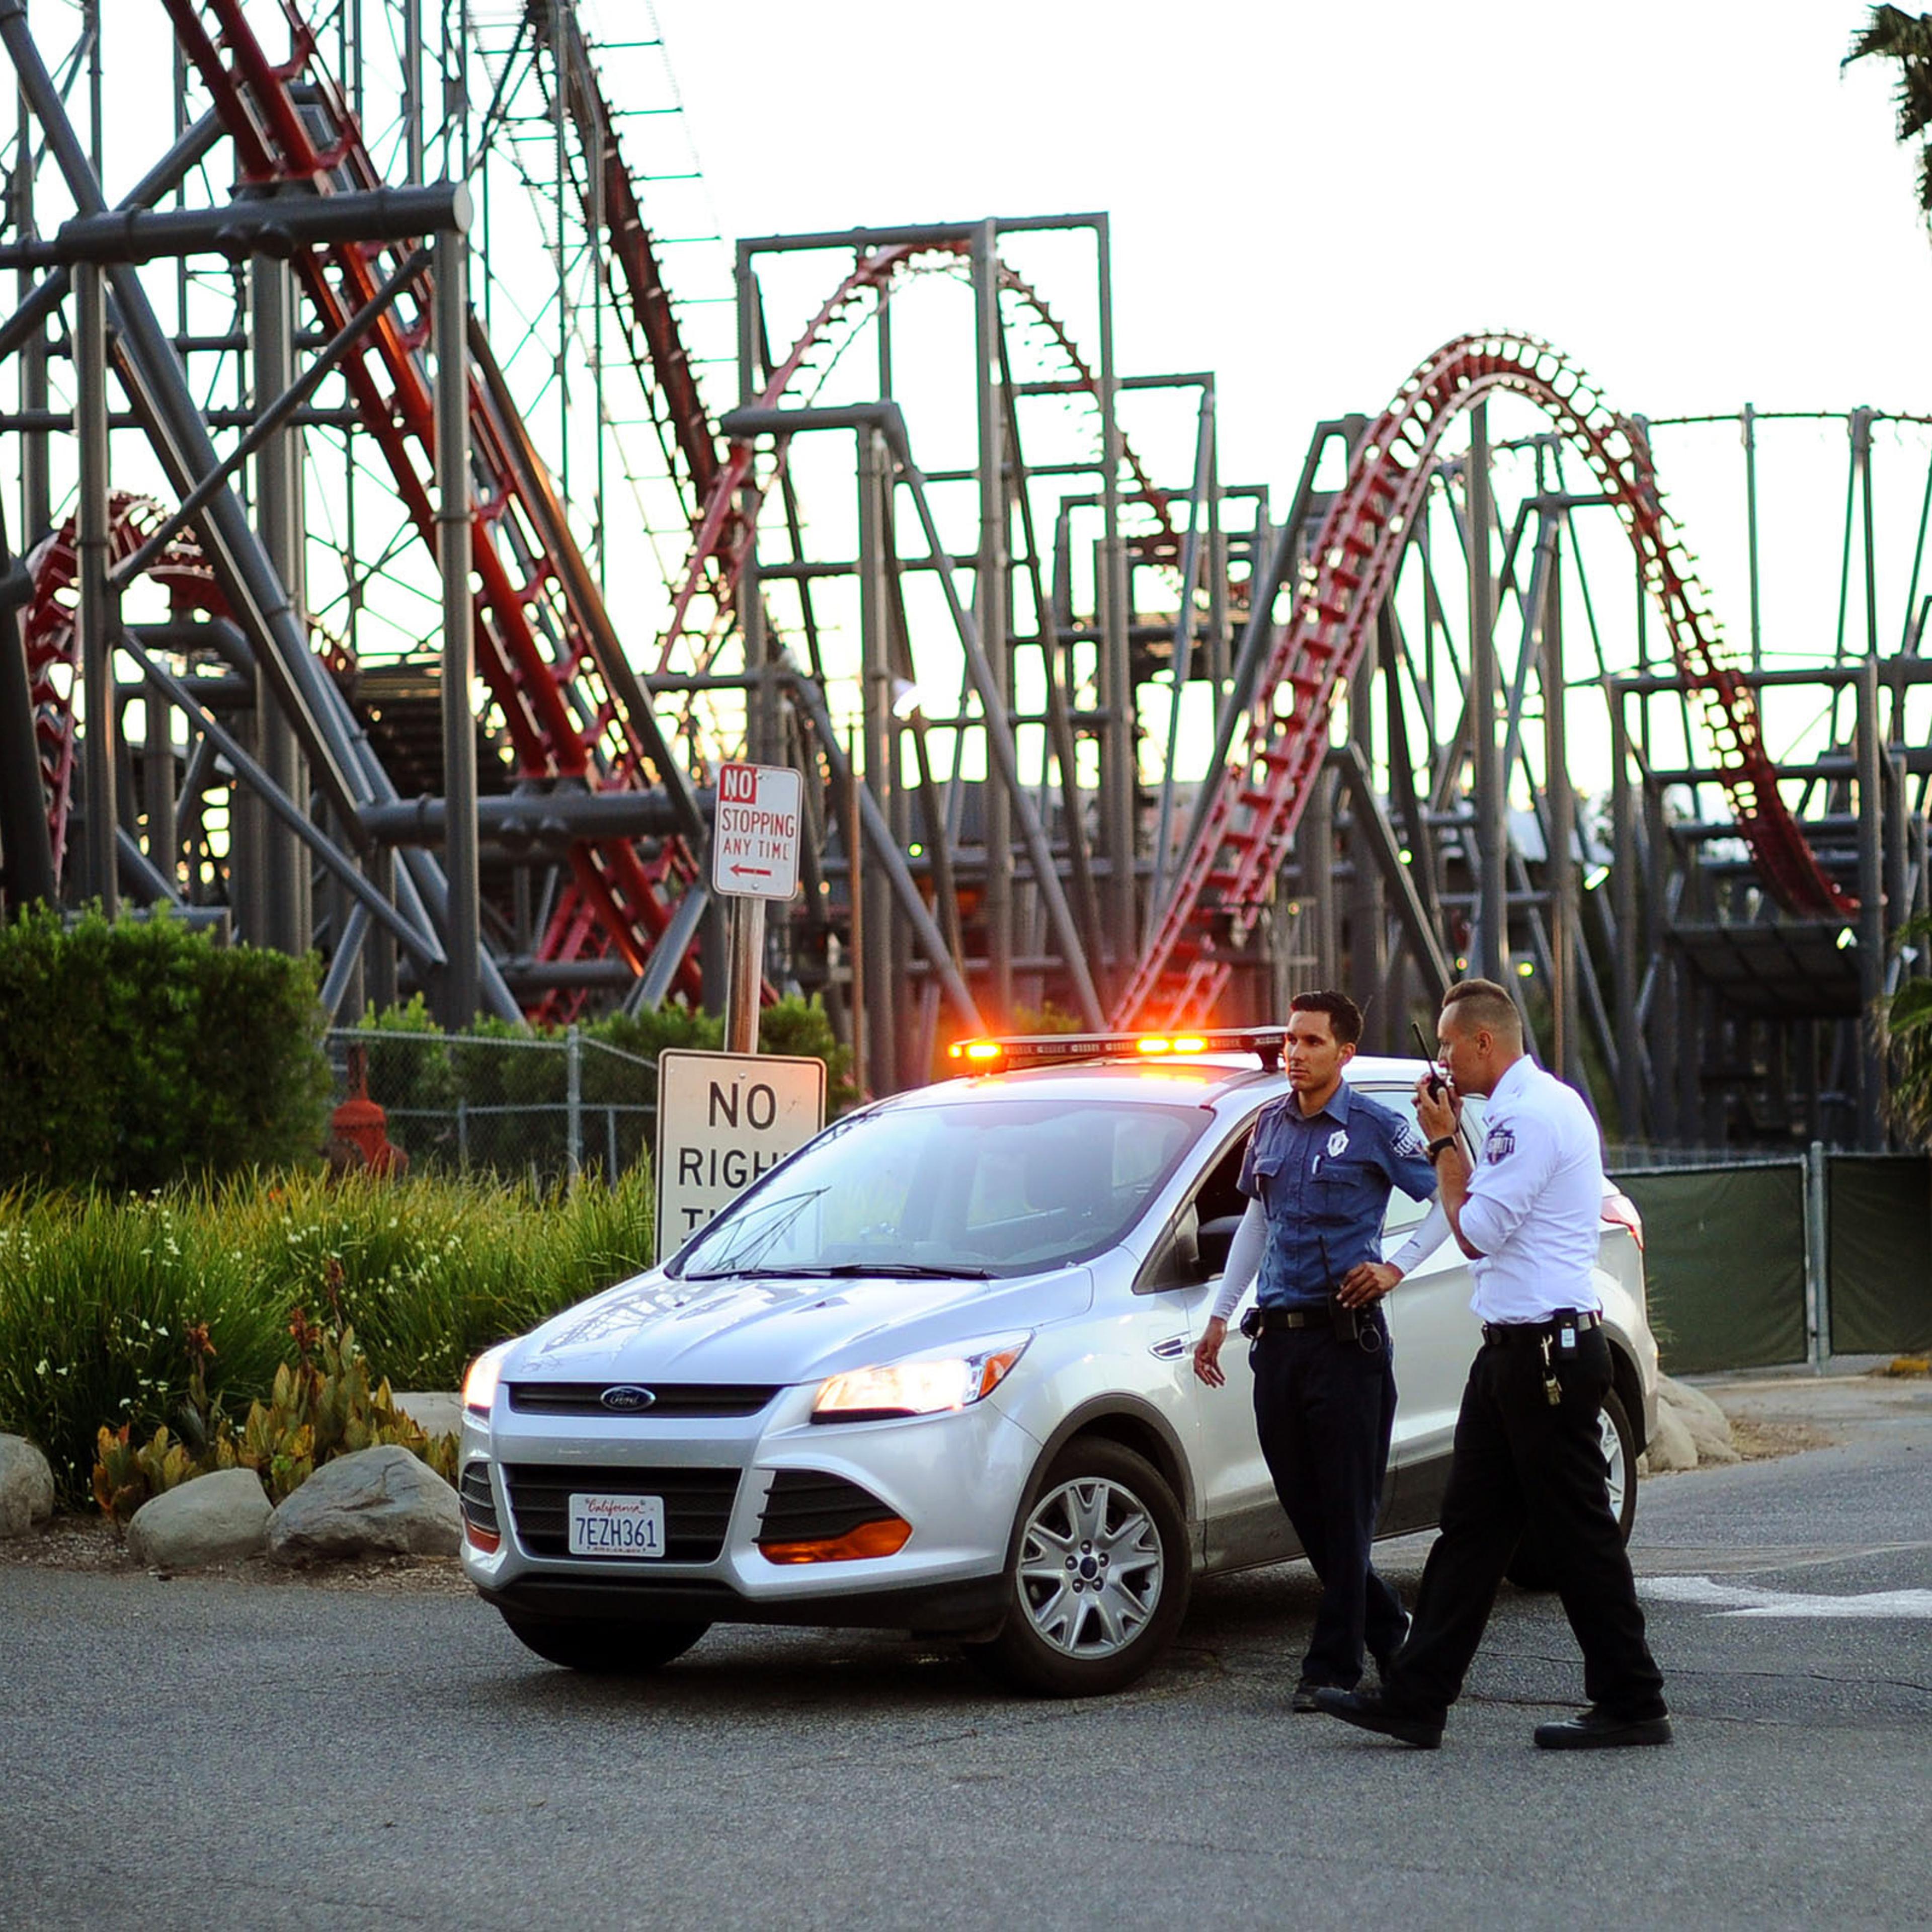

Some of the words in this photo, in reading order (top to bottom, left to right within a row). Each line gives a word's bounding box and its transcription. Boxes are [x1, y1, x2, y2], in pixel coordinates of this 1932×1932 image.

[725, 769, 753, 798] NO
[721, 808, 794, 838] STOPPING
[723, 837, 751, 856] ANY
[759, 840, 788, 861] TIME
[709, 1081, 776, 1130] NO
[679, 1147, 790, 1189] RIGH
[588, 1498, 646, 1516] California
[576, 1517, 657, 1548] 7EZH361
